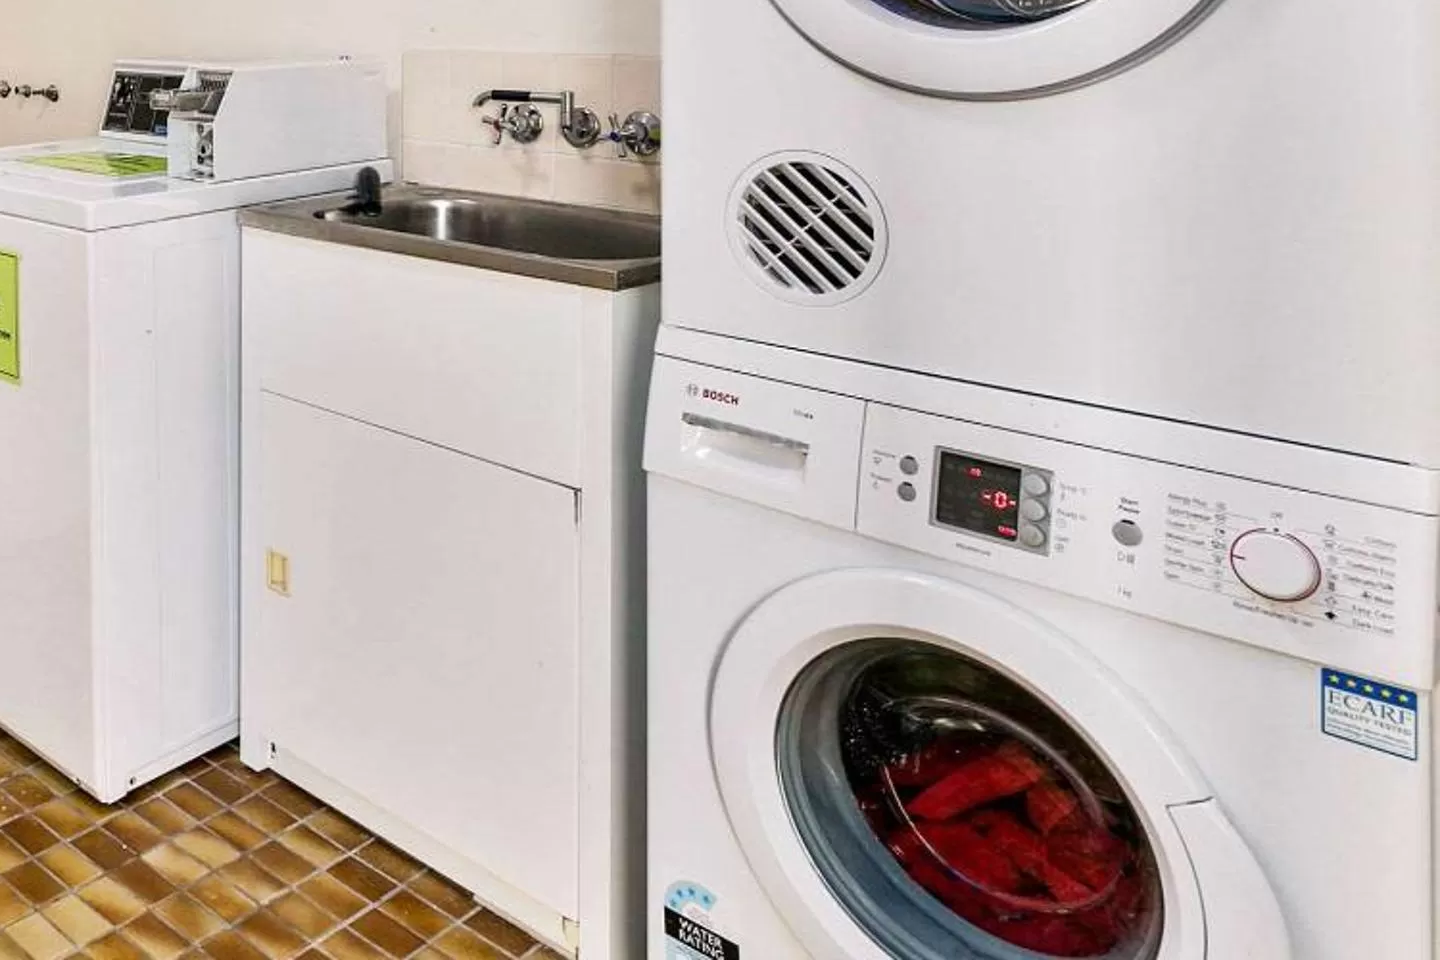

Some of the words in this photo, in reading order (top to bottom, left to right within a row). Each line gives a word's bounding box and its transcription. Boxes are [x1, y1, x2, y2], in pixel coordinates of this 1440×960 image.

[702, 388, 740, 405] BOSCH
[679, 917, 723, 949] WATER
[679, 928, 725, 960] RATING
